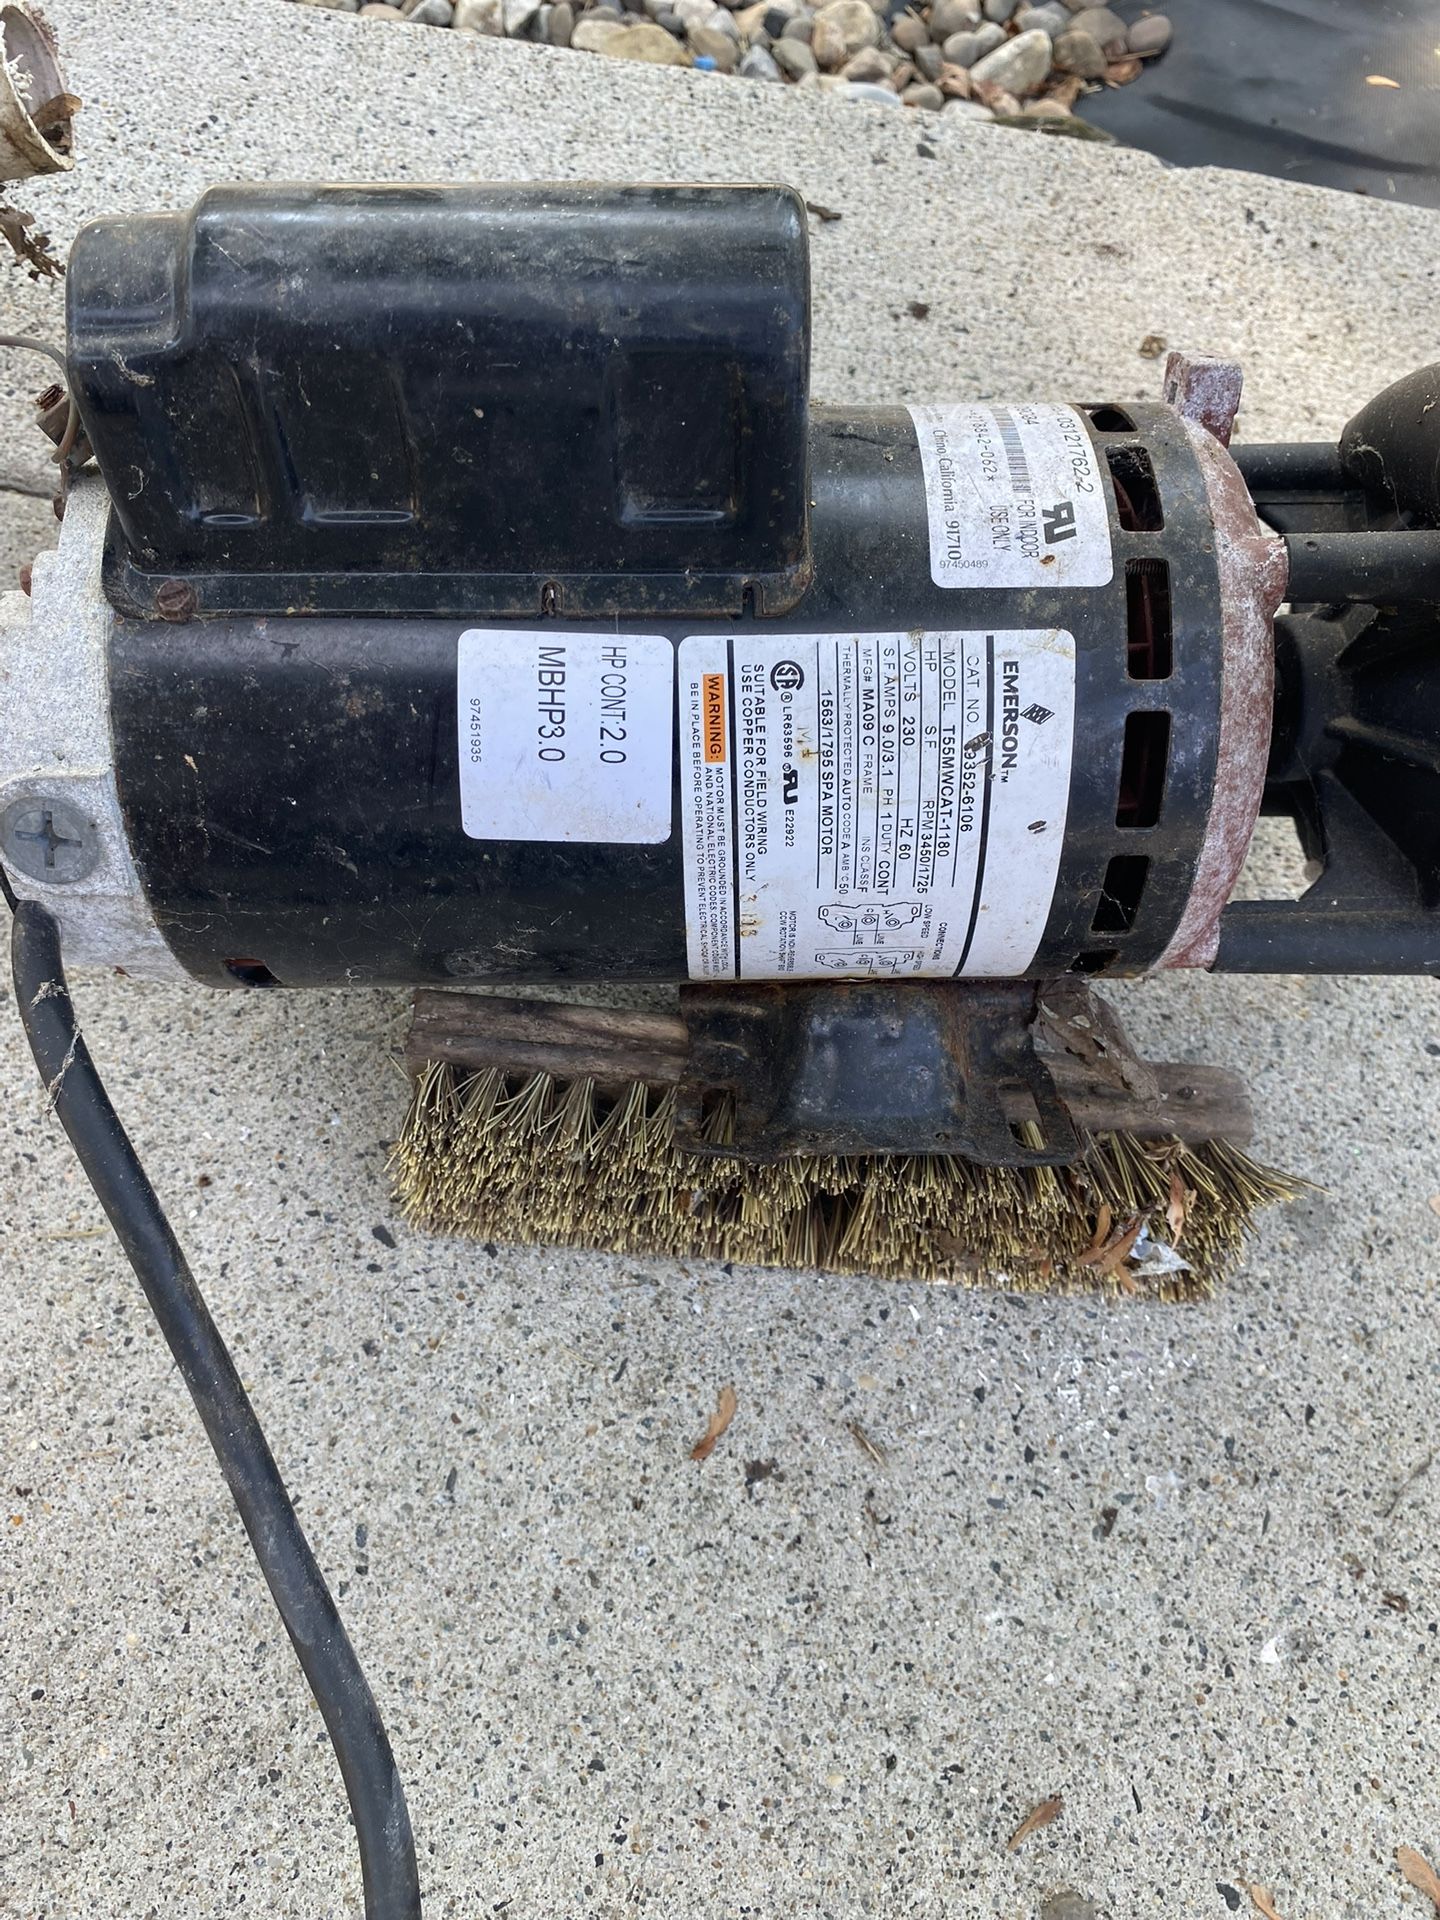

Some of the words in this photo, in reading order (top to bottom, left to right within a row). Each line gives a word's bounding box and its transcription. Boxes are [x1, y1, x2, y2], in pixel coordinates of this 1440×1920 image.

[938, 458, 956, 512] California
[990, 505, 1009, 523] USE
[1017, 500, 1035, 518] FOR
[946, 521, 962, 560] 91710
[992, 526, 1011, 552] ONLY
[1018, 521, 1039, 558] INDOOR
[940, 560, 988, 568] 97450489
[601, 646, 626, 668] HP
[862, 649, 872, 682] MFG#
[924, 650, 936, 672] HP
[966, 656, 980, 692] CAT.
[690, 682, 699, 696] BE
[742, 664, 752, 692] USE
[842, 647, 852, 710] THERMALLY
[903, 650, 916, 702] VOLTS
[942, 650, 956, 711] MODEL
[538, 646, 566, 762] MBHP3.0
[691, 700, 700, 710] IN
[754, 664, 766, 733] SUITABLE
[862, 689, 874, 730] MA09
[966, 699, 979, 727] NO.
[1002, 661, 1019, 768] EMERSON
[470, 698, 482, 763] 97451935
[692, 714, 700, 748] PLACE
[708, 676, 722, 760] WARNING:
[742, 698, 754, 754] COPPER
[782, 706, 792, 758] LR63596
[821, 690, 834, 768] 1563/1795
[902, 716, 916, 746] 230
[756, 738, 767, 766] FOR
[842, 713, 852, 776] PROTECTED
[862, 736, 874, 746] C
[881, 724, 894, 776] 9.0/3.1
[924, 725, 936, 752] S.F.
[692, 752, 702, 792] BEFORE
[704, 768, 713, 788] AND
[716, 768, 724, 804] MOTOR
[756, 770, 767, 808] FIELD
[822, 772, 834, 801] SPA
[862, 754, 872, 794] FRAME
[743, 760, 756, 849] CONDUCTORS
[842, 778, 852, 810] AUTO
[882, 788, 893, 806] PH
[937, 725, 955, 857] T55MWCAT-1180
[694, 796, 704, 850] OPERATING
[706, 792, 715, 840] NATIONAL
[716, 806, 726, 832] MUST
[785, 810, 794, 847] E22922
[821, 806, 833, 855] MOTOR
[842, 813, 851, 840] CODE
[880, 812, 893, 820] 1
[900, 818, 913, 838] HZ
[921, 800, 934, 830] RPM
[717, 835, 726, 848] BE
[756, 811, 768, 855] WIRING
[841, 842, 850, 850] A
[860, 836, 871, 852] INS
[881, 824, 892, 854] DUTY
[696, 853, 704, 864] TO
[706, 843, 716, 884] ELECTRIC
[744, 852, 756, 882] ONLY
[841, 853, 850, 870] AMB
[898, 844, 911, 860] 60
[916, 833, 932, 894] 3450/1725
[696, 866, 706, 902] PREVENT
[718, 850, 727, 896] GROUNDED
[860, 856, 871, 886] CLASS
[876, 860, 890, 895] CONT
[838, 884, 848, 894] 50
[698, 904, 708, 940] ELECTRICAL
[719, 906, 728, 948] ACCORDANCE
[788, 911, 796, 932] MOTOR
[924, 904, 933, 918] LOW
[710, 914, 719, 950] COMPONENT
[920, 920, 930, 938] SPEED
[932, 922, 948, 960] CONNECTIONS
